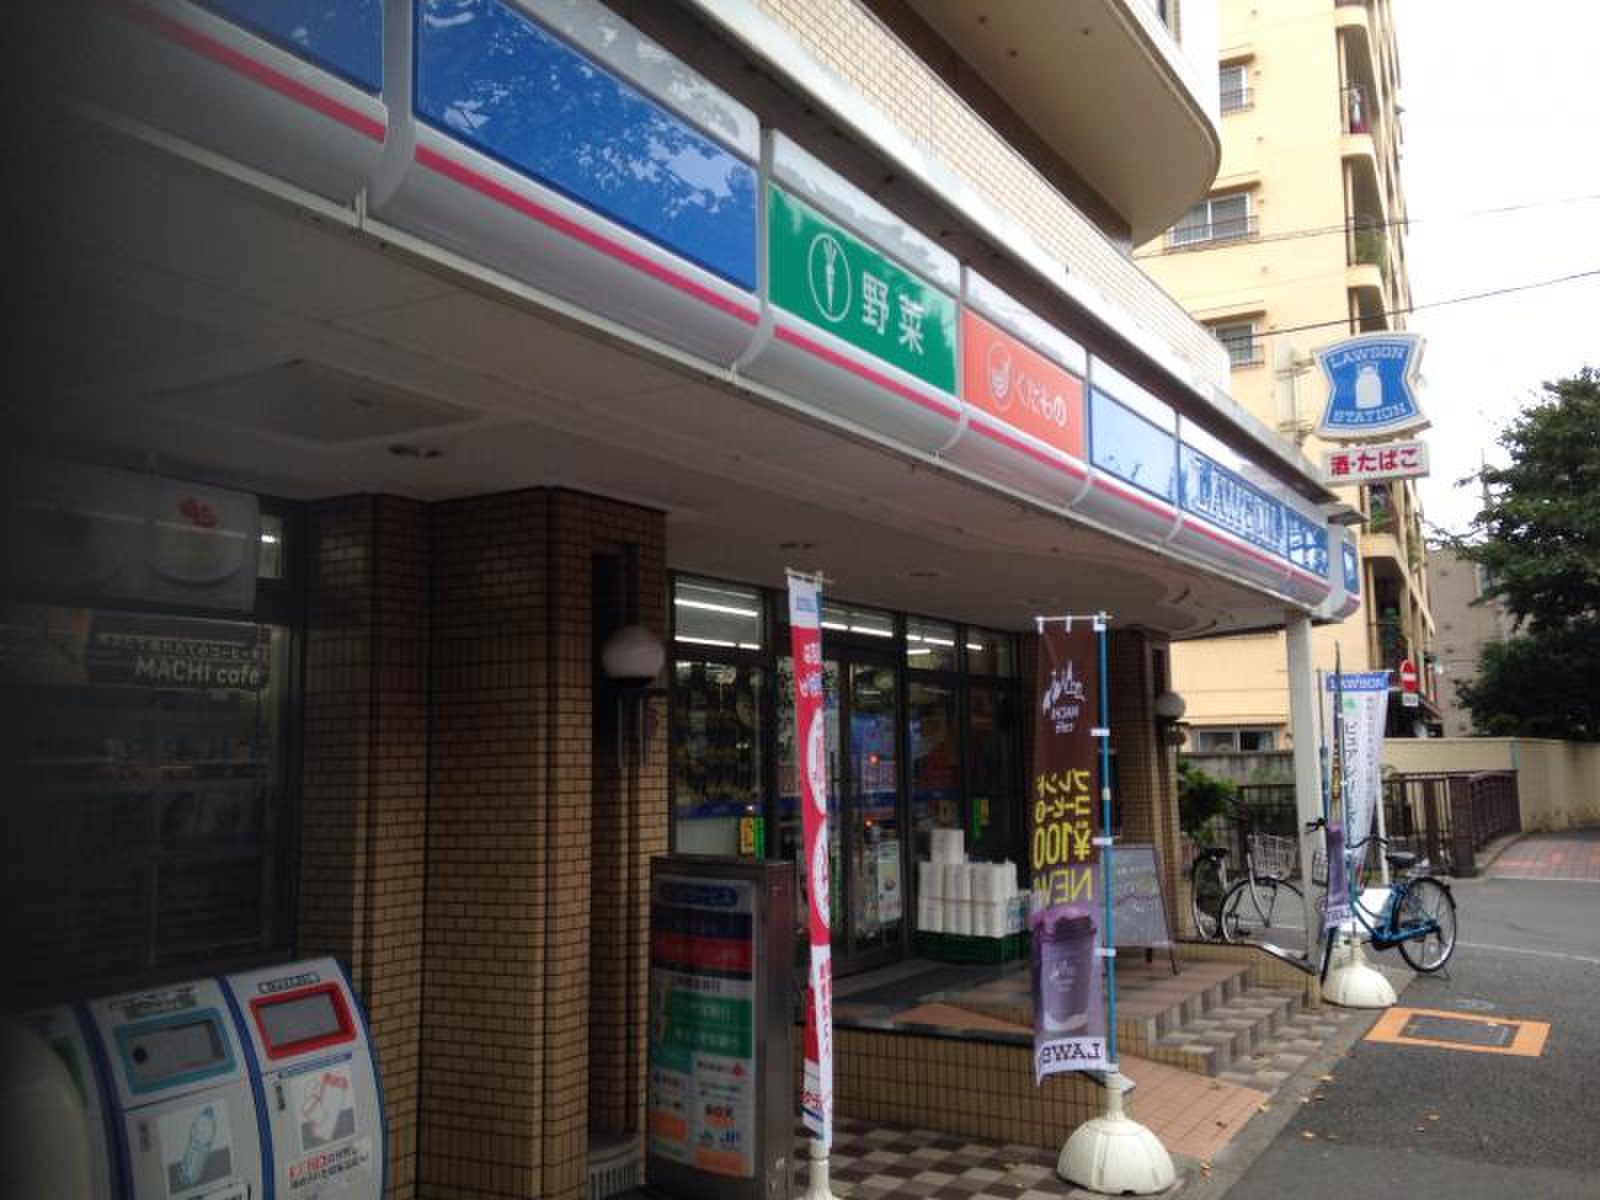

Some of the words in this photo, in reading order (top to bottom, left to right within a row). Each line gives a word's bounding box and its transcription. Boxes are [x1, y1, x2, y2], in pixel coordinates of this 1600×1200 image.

[861, 270, 926, 356] 野菜
[1328, 345, 1406, 369] LAWSON
[1012, 367, 1069, 429] くだもの
[1331, 401, 1408, 424] STATION
[1330, 446, 1419, 477] 酒・たばこ
